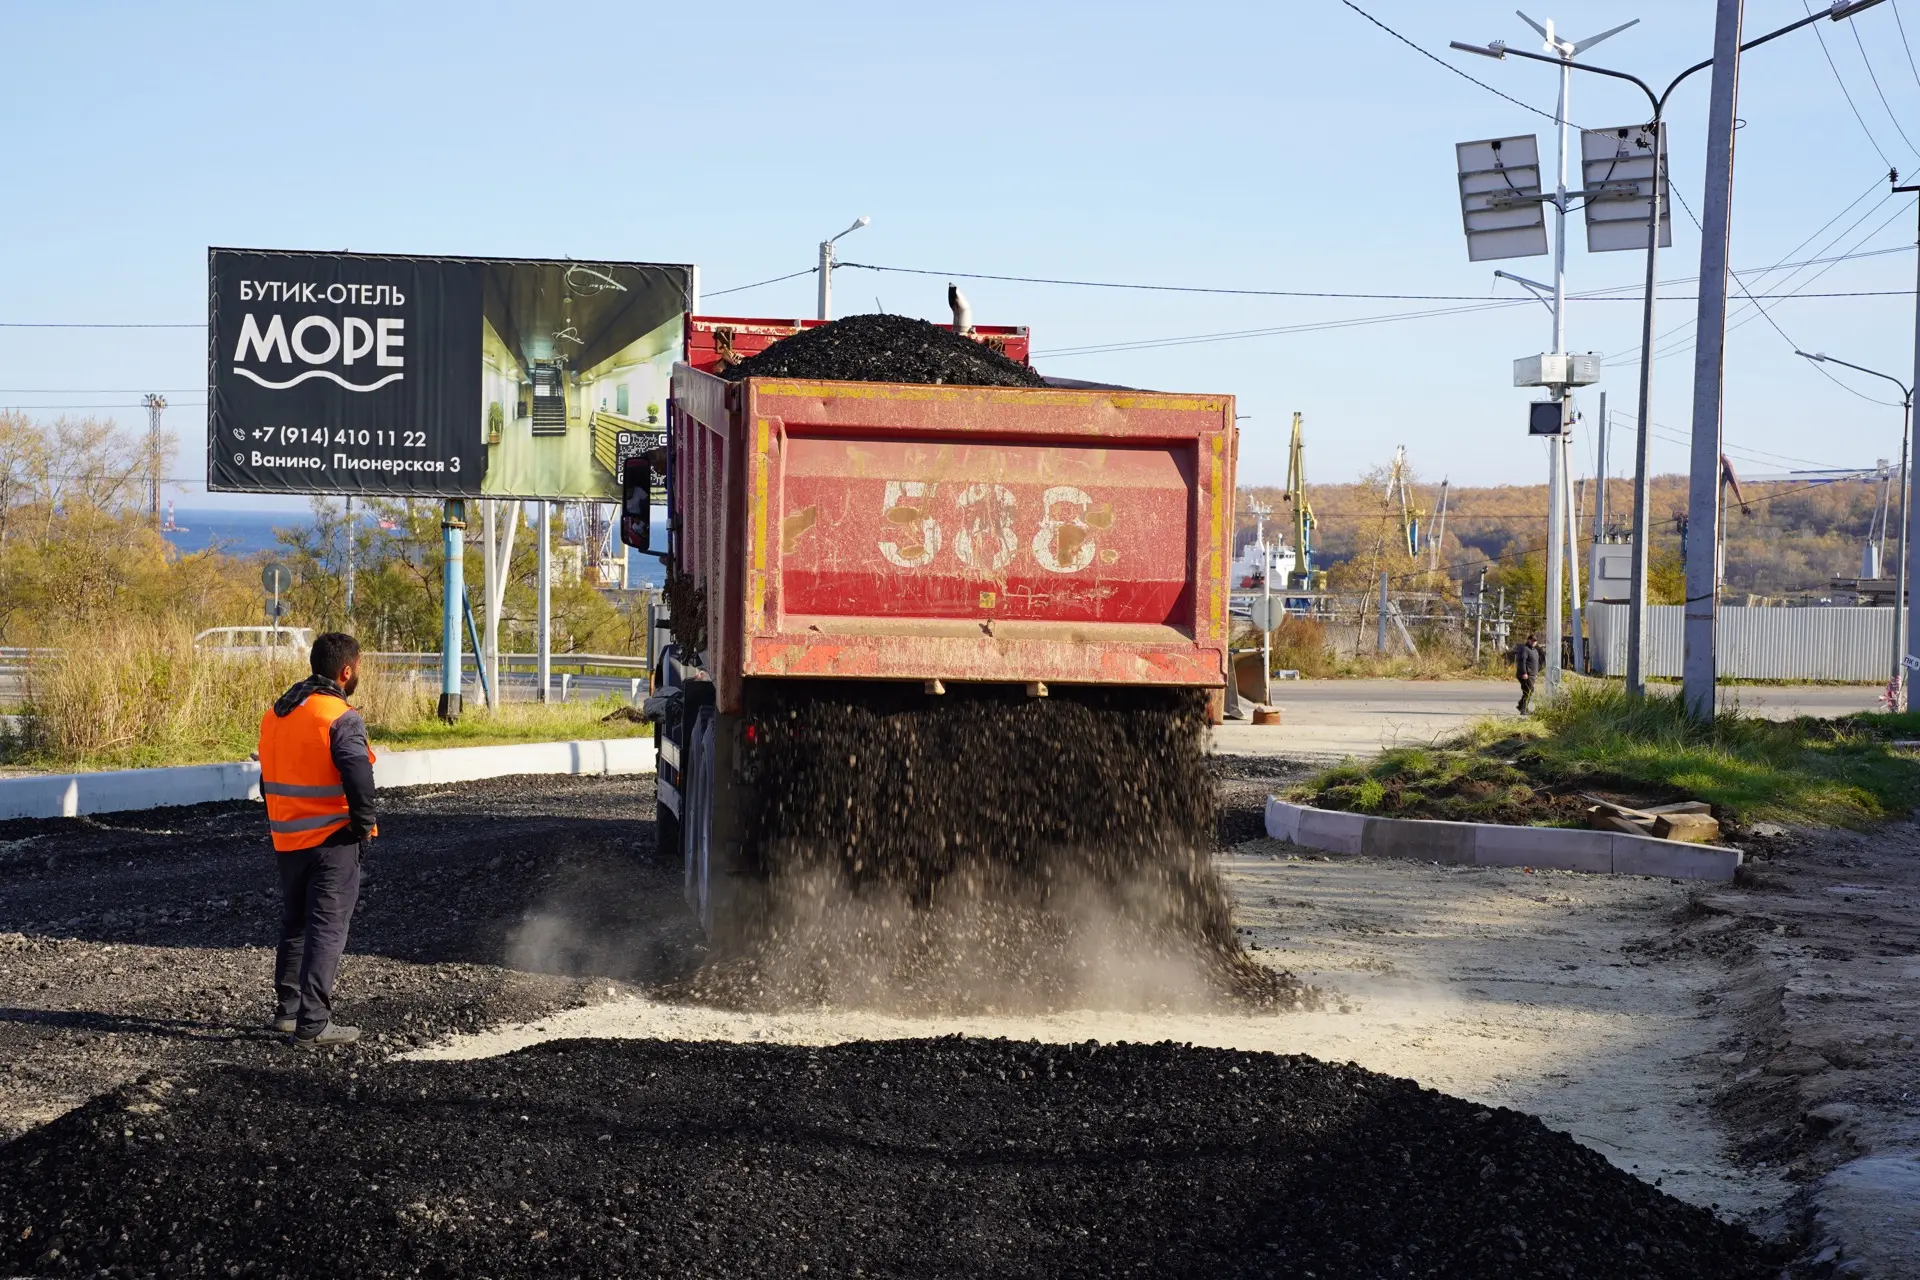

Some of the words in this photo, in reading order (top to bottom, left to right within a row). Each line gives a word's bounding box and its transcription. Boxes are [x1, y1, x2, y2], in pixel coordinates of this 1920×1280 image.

[240, 280, 405, 305] БУТИК-ОТЕЛЬ
[233, 313, 405, 367] МОРЕ
[251, 426, 276, 443] +7
[280, 425, 329, 447] (914)
[333, 428, 370, 446] 410
[376, 430, 396, 447] 11
[403, 430, 427, 448] 22
[251, 450, 327, 471] Ванино,
[333, 453, 445, 475] Пионерская
[449, 456, 461, 473] 3
